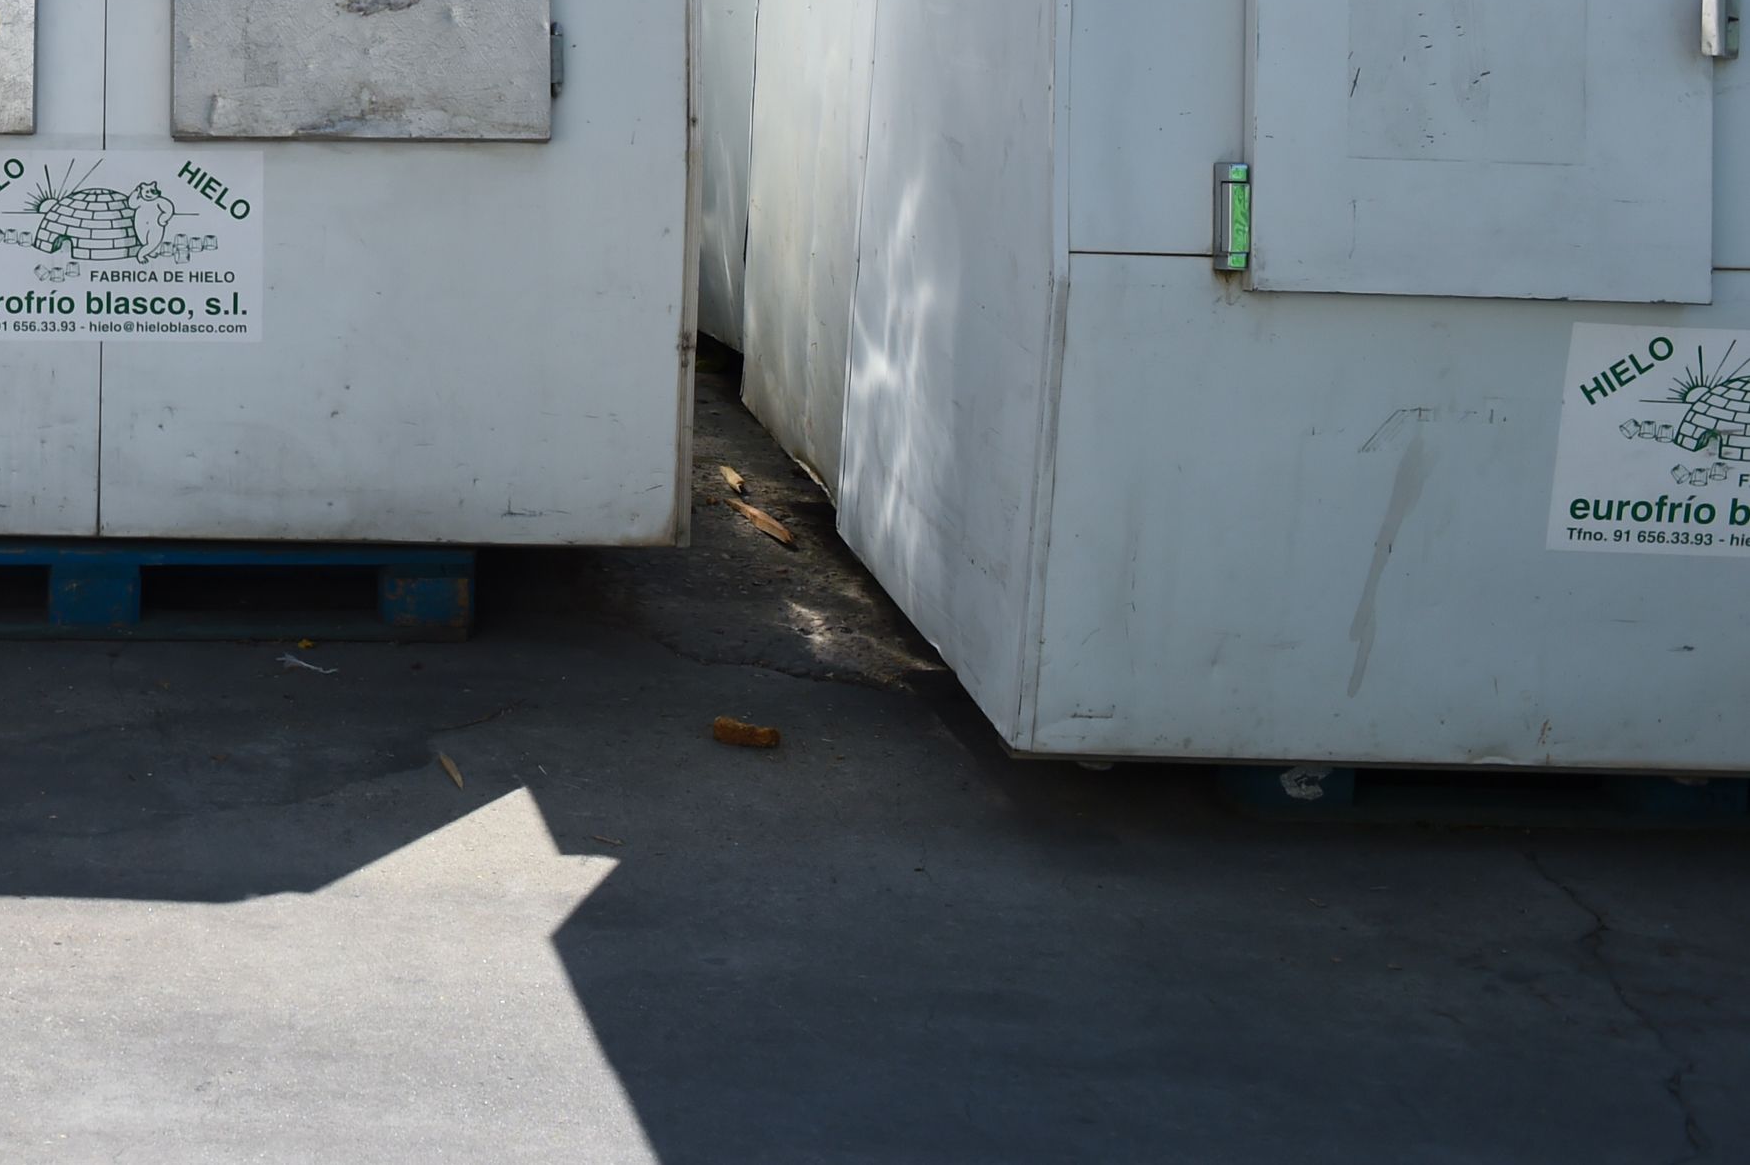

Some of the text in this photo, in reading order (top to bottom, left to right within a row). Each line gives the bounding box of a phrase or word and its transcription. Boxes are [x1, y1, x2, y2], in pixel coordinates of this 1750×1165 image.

[177, 160, 250, 220] HIELO
[90, 271, 235, 283] FABRICA DE HIELO
[86, 291, 194, 320] blasco,
[205, 292, 248, 316] s.l.
[13, 321, 76, 333] 656.33.93
[89, 321, 247, 334] hielo@hieloblasco.com
[1580, 336, 1674, 406] HIELO
[1569, 495, 1716, 525] eurofrío
[1566, 528, 1608, 542] Tfno.
[1613, 529, 1631, 543] 91
[1637, 530, 1713, 546] 656.33.93
